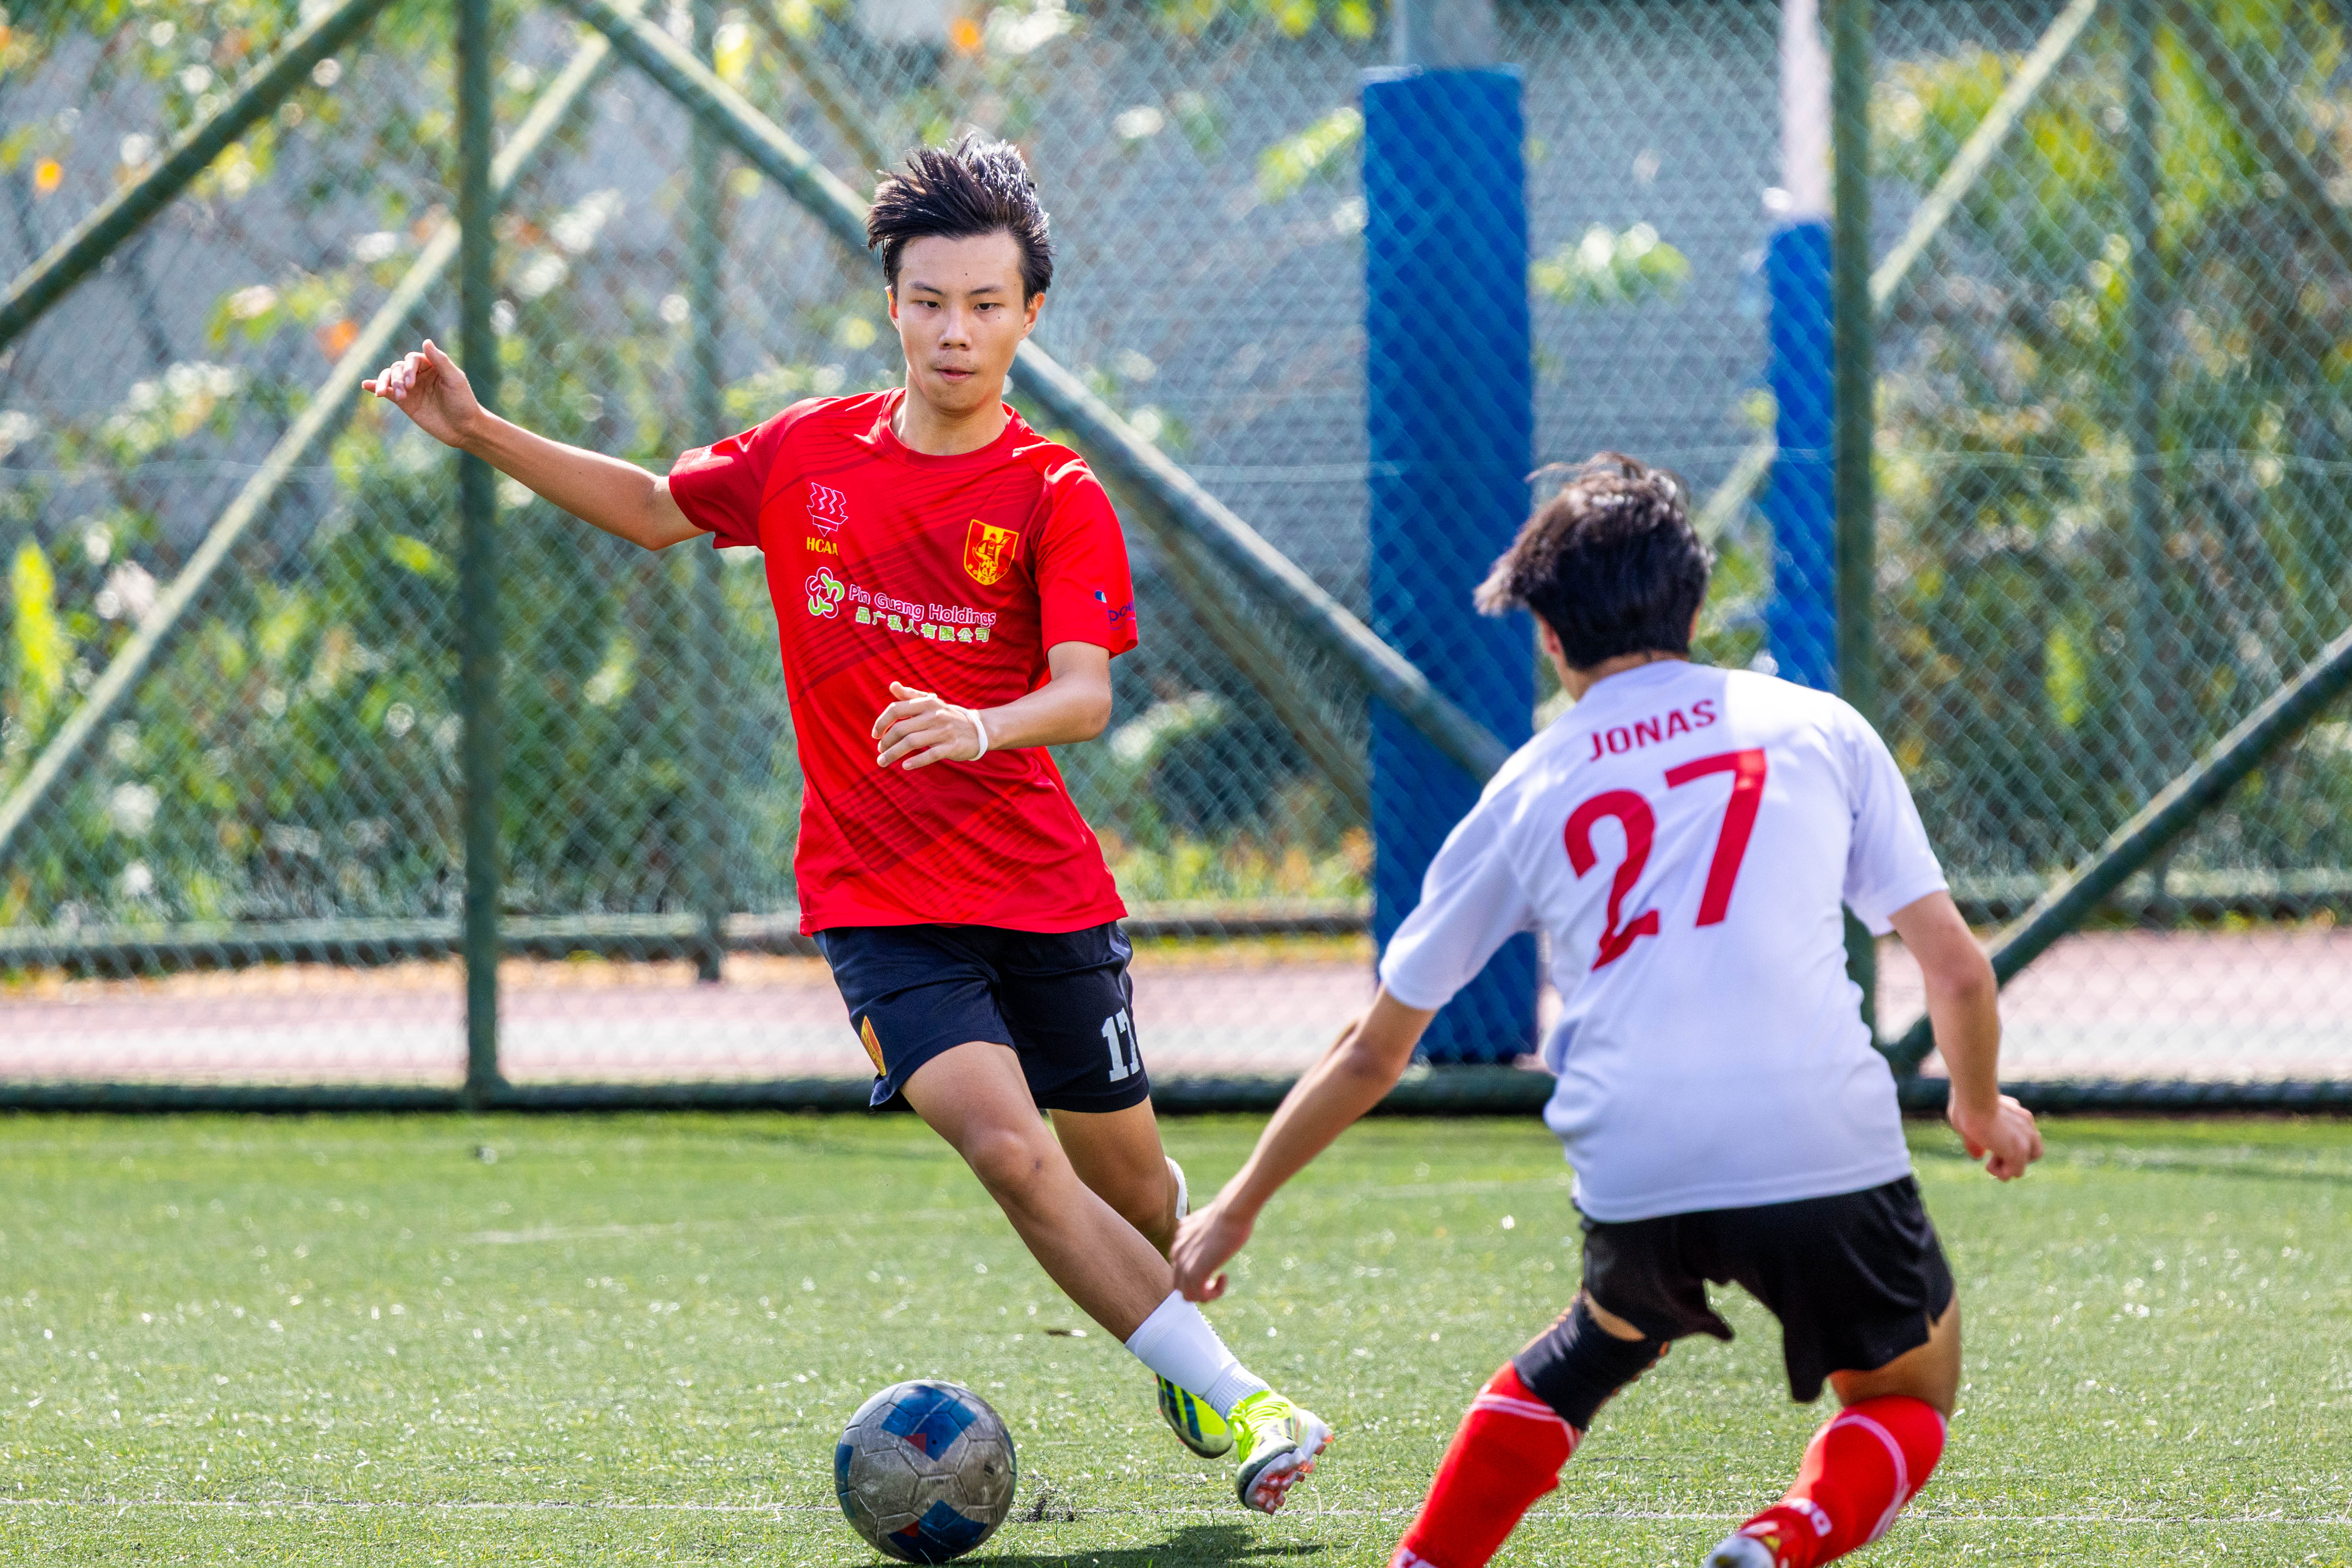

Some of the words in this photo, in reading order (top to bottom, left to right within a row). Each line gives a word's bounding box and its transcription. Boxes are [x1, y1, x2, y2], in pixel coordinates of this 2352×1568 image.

[807, 536, 838, 556] HCAA
[849, 584, 871, 605] Pin
[874, 593, 925, 621] Guang
[929, 603, 996, 628] Holdings
[856, 606, 990, 643] 品广私人有限公司
[1590, 699, 1717, 762] JONAS
[1564, 747, 1767, 972] 27
[1101, 1007, 1140, 1082] 17
